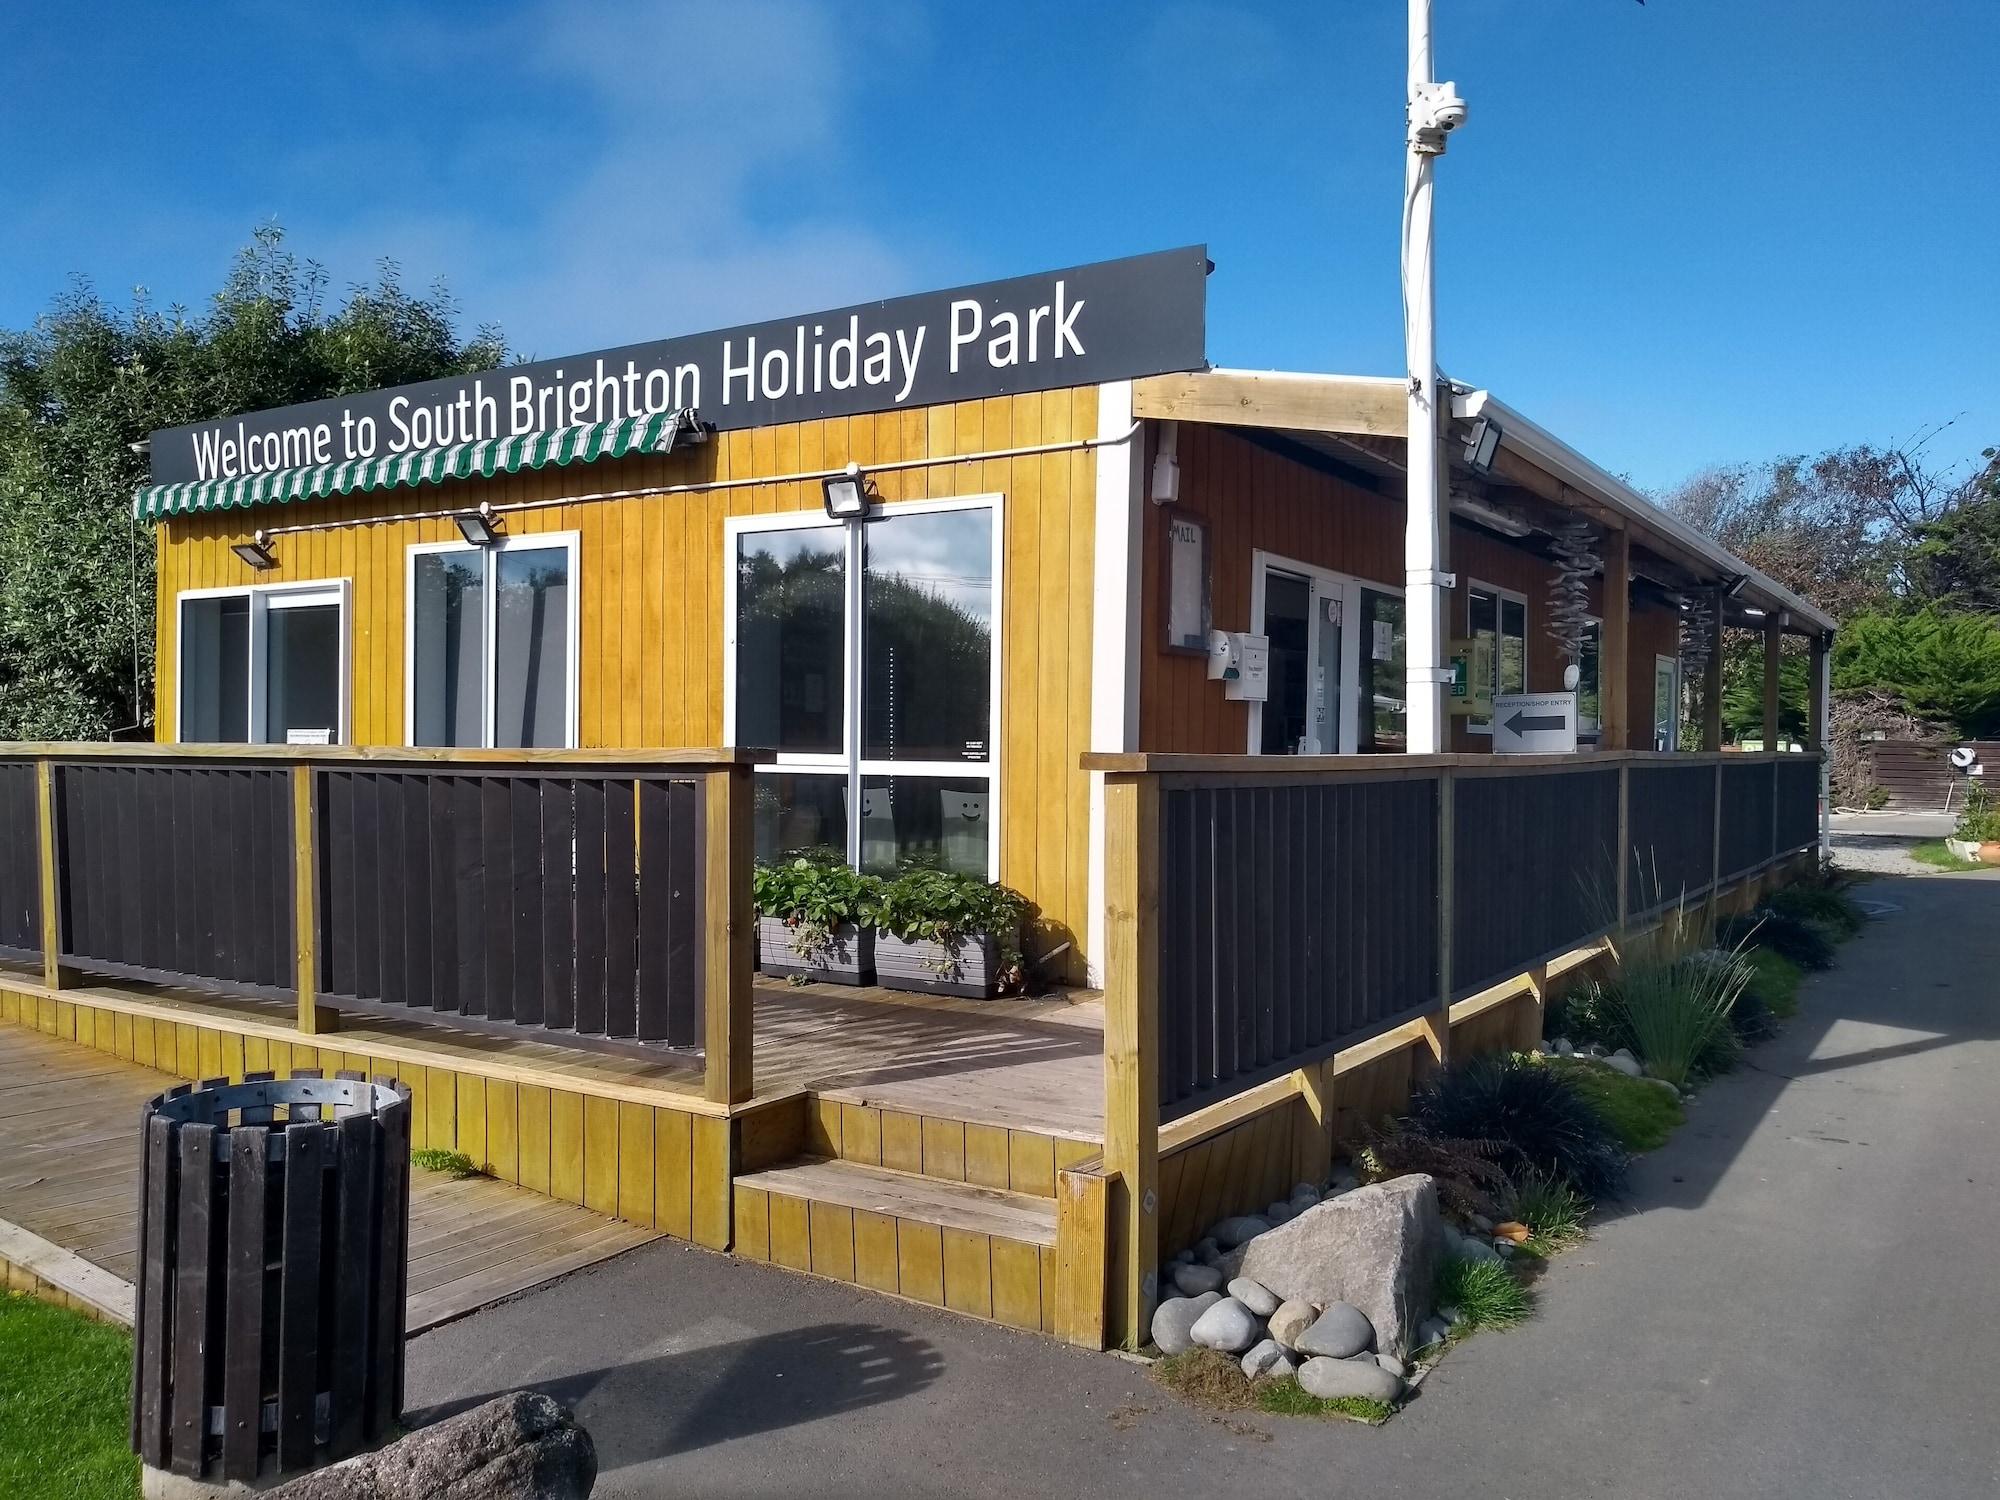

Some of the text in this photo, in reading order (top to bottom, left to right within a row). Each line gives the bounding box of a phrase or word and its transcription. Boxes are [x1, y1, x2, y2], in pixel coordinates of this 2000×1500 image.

[192, 279, 1085, 480] Welcome to South Brighton Holiday Park
[1172, 525, 1196, 543] MAIL
